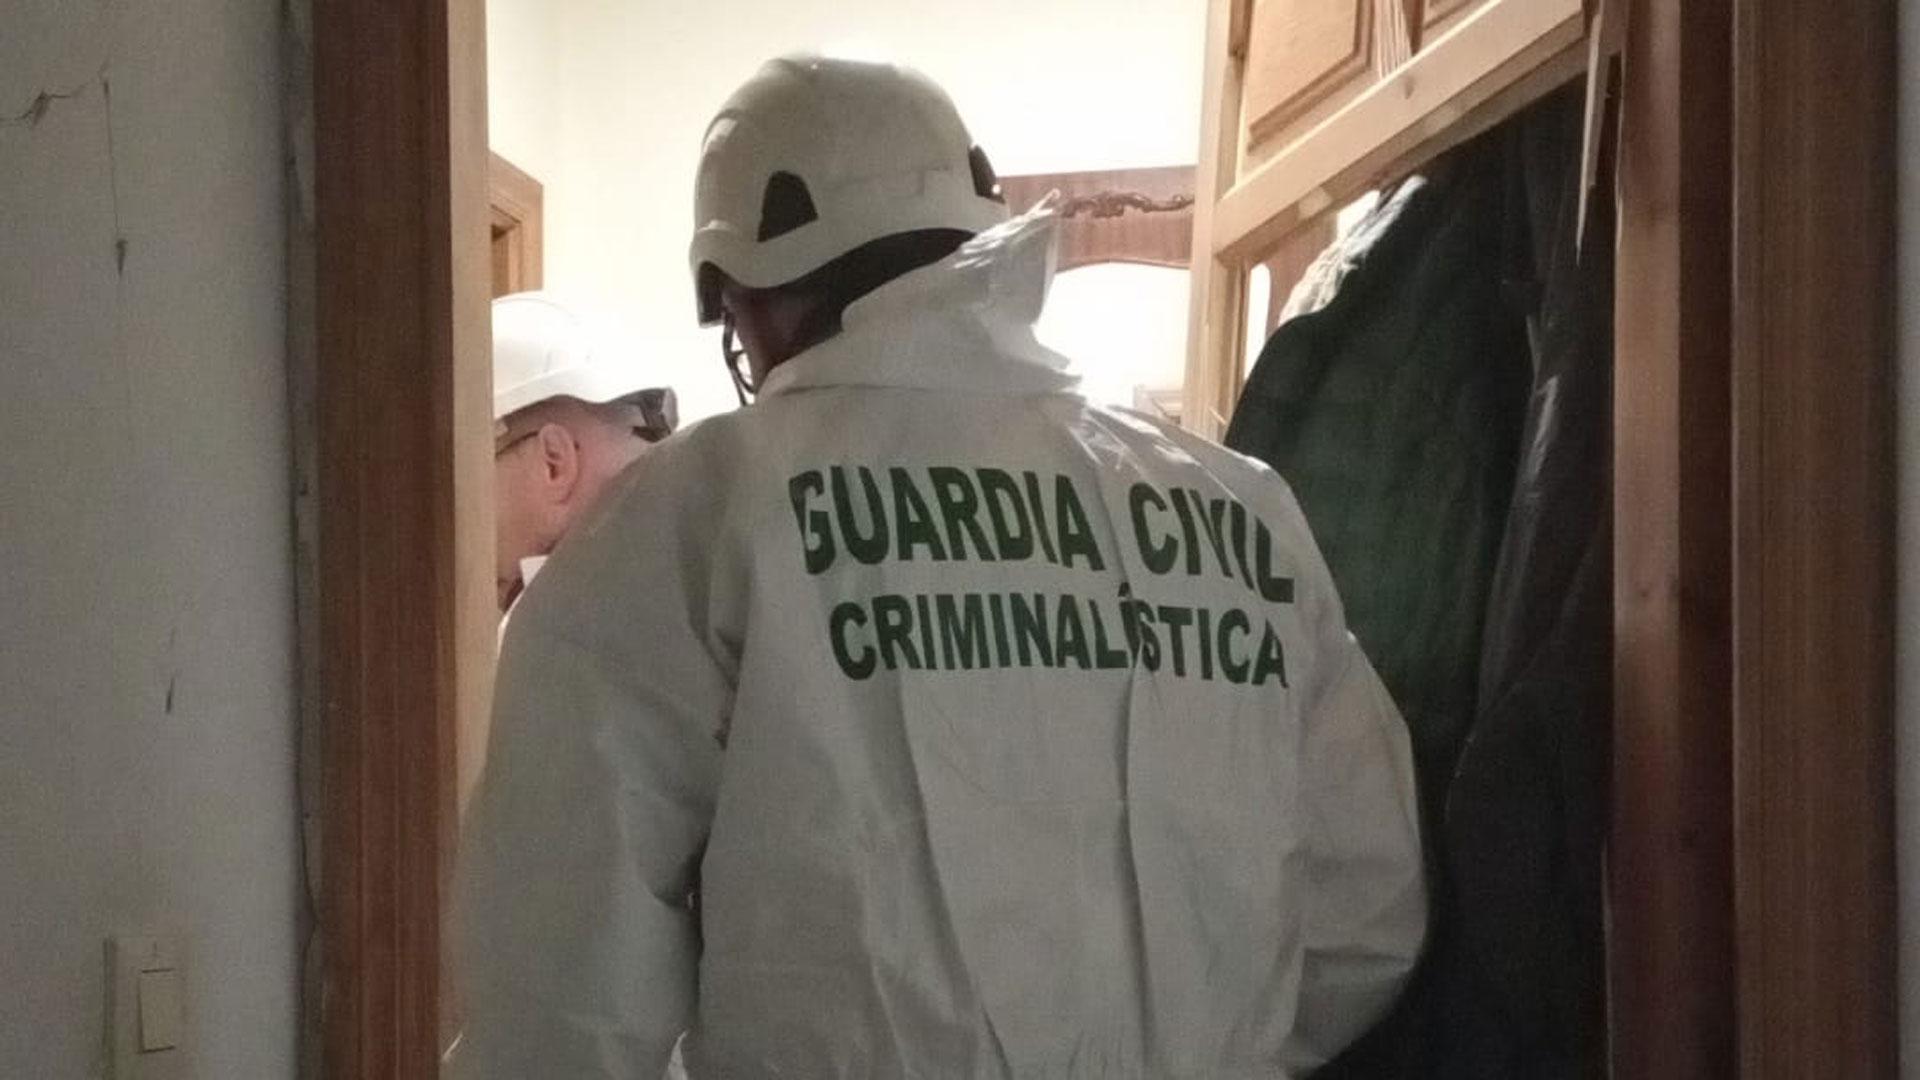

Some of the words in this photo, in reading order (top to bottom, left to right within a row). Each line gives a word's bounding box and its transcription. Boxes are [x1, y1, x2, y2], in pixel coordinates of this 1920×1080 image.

[788, 466, 1106, 575] GUARDIA
[1128, 482, 1295, 603] CIVIL
[829, 582, 1289, 689] CRIMINALÍSTICA
